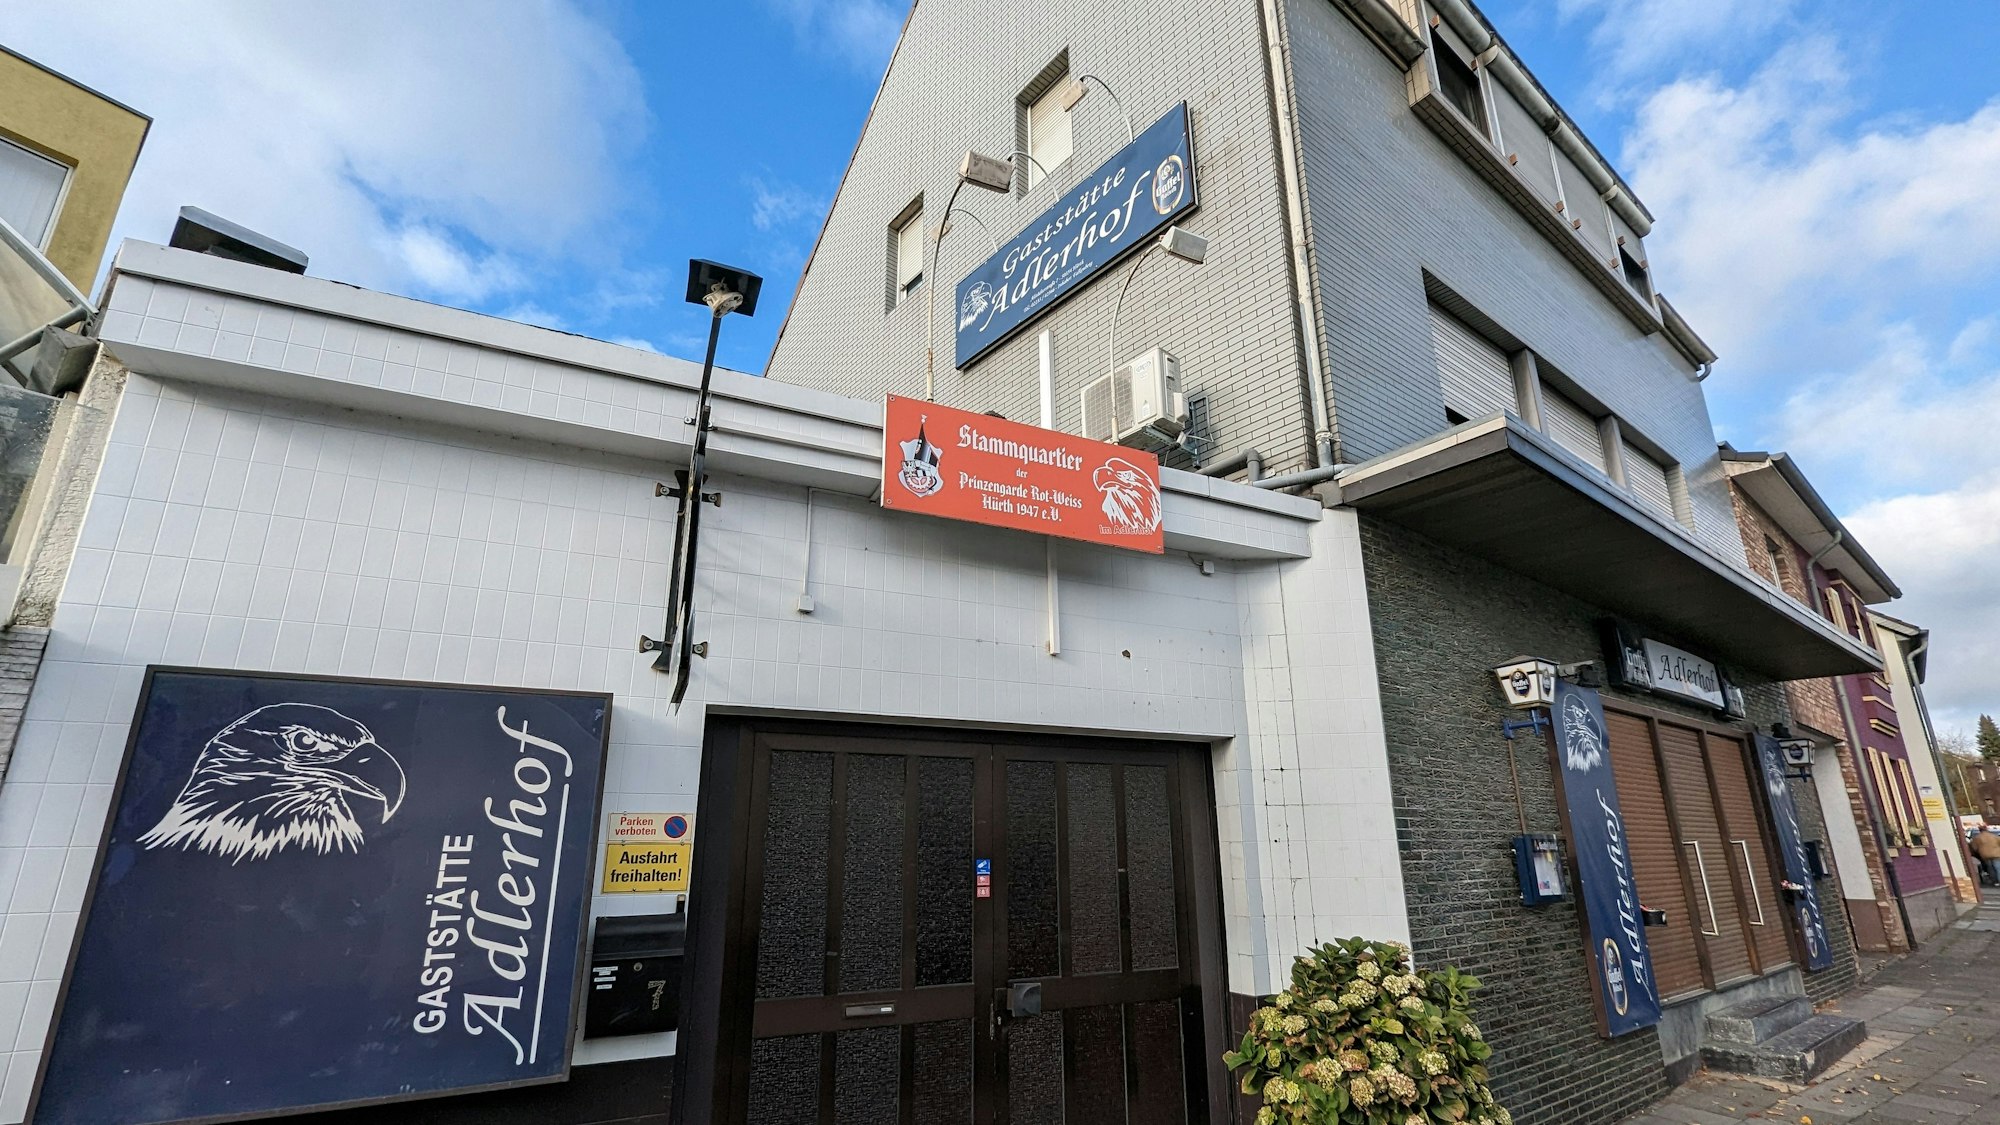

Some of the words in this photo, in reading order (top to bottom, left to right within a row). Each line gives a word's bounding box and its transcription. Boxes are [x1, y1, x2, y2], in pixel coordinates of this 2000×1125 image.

[1003, 167, 1126, 279] Gaststätte
[979, 170, 1150, 332] Adlerhof
[957, 424, 1083, 471] Stammquartier
[959, 471, 1028, 498] Prinzengarde
[1030, 485, 1082, 509] Rot-Weiss
[1016, 468, 1028, 478] der
[982, 494, 1014, 514] Hürth
[1016, 502, 1039, 518] 1947
[1659, 654, 1715, 692] Adlerhof
[615, 826, 657, 836] verboten
[620, 816, 654, 826] Parken
[610, 868, 682, 883] freihalten!
[619, 851, 678, 865] Ausfahrt
[463, 705, 573, 1066] Adlerhof
[1597, 788, 1652, 1001] Adlerhof
[413, 834, 474, 1034] GASTSTÄTTE
[647, 979, 667, 1011] 7
